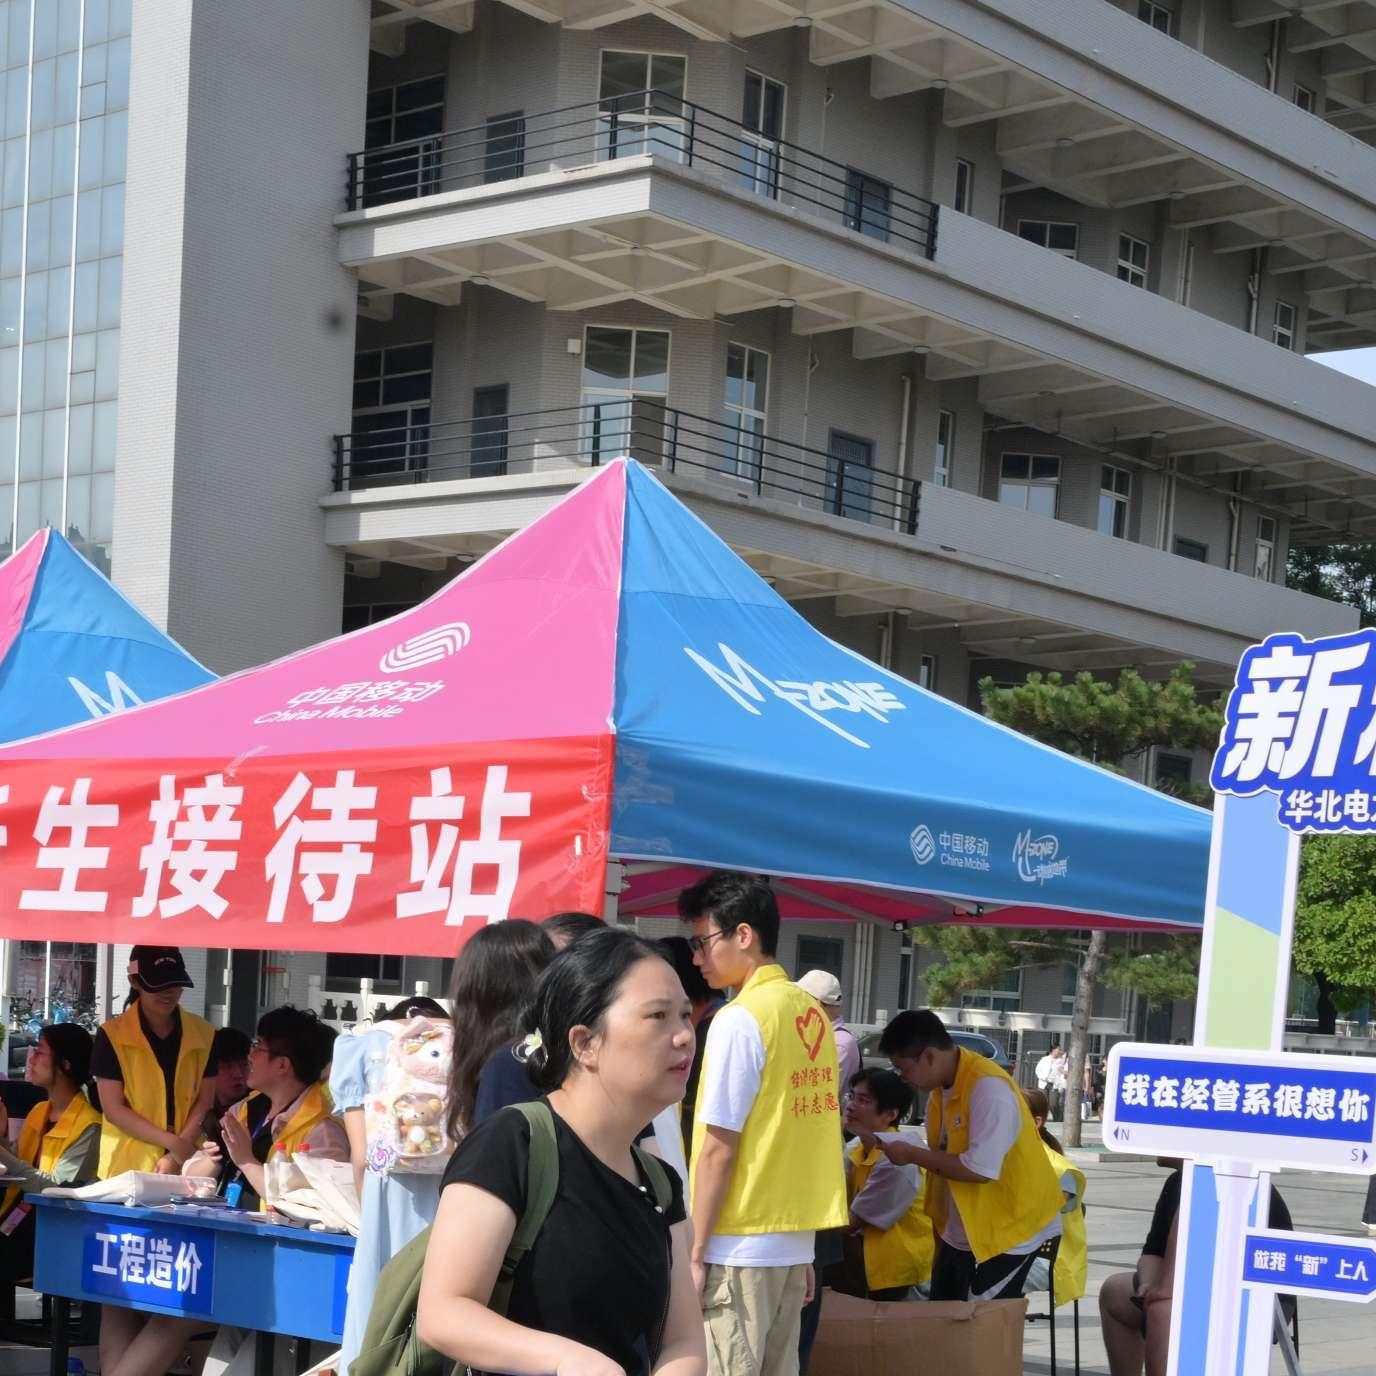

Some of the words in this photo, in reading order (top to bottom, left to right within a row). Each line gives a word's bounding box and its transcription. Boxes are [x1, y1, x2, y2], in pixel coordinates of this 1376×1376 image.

[288, 680, 446, 708] 中国移动
[252, 706, 318, 726] China
[318, 703, 405, 721] Mobile
[939, 831, 990, 857] 中国移动
[940, 853, 964, 869] China
[965, 856, 992, 872] Mobile
[1121, 1072, 1370, 1124] 我在经管系很想你
[1120, 1128, 1130, 1142] N
[1350, 1148, 1359, 1162] S
[92, 1231, 203, 1296] 工程造价
